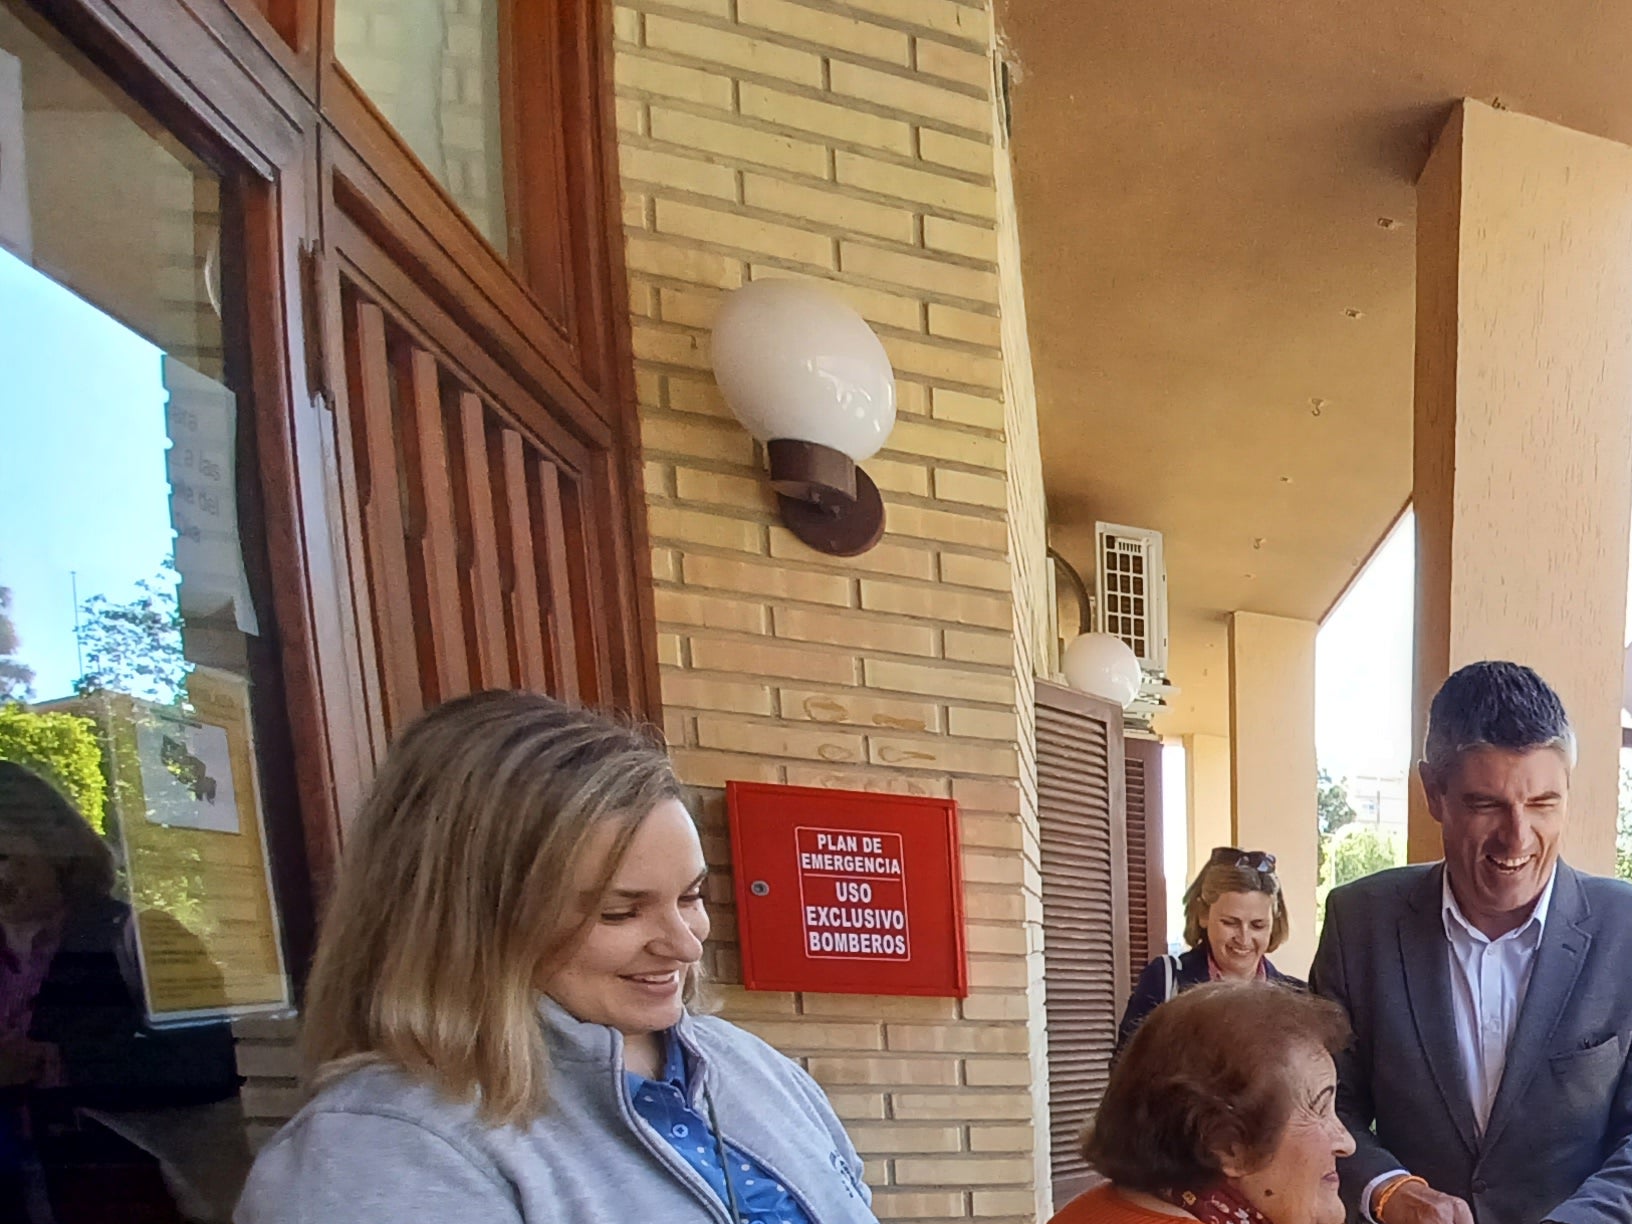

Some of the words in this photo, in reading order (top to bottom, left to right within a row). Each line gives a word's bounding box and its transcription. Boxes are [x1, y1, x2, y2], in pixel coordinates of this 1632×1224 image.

[817, 833, 857, 852] PLAN
[862, 837, 882, 854] DE
[801, 853, 901, 874] EMERGENCIA
[835, 881, 872, 903] USO
[806, 906, 904, 930] EXCLUSIVO
[809, 931, 905, 954] BOMBEROS
